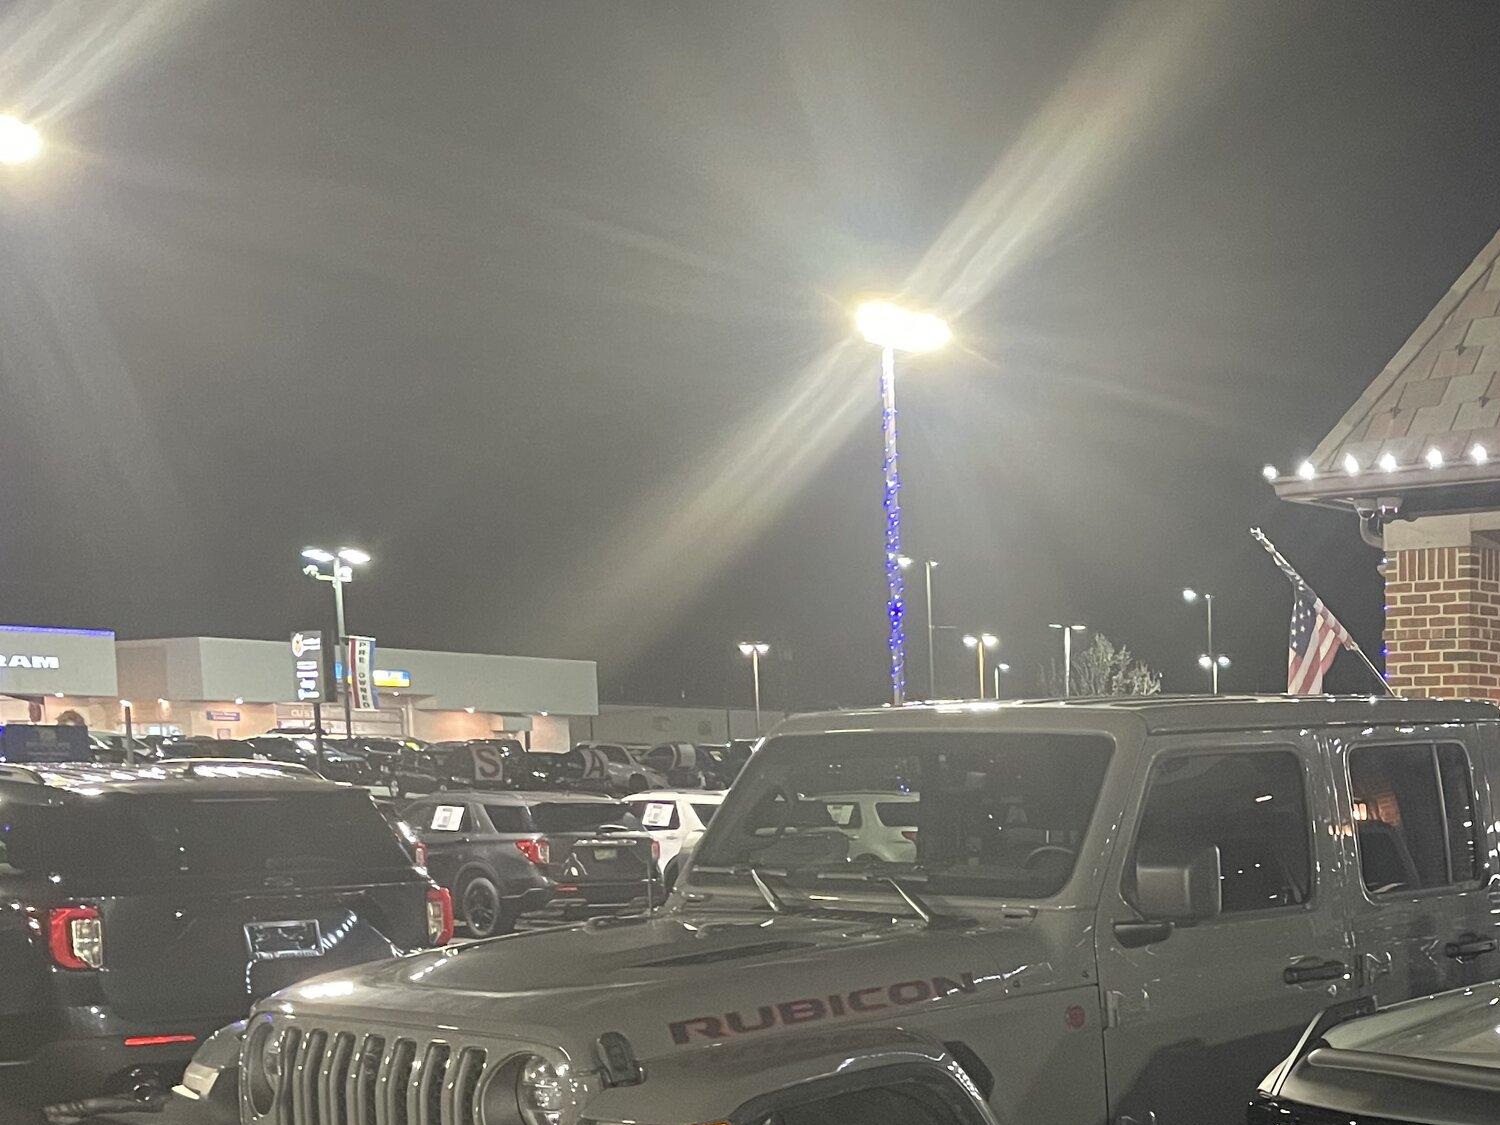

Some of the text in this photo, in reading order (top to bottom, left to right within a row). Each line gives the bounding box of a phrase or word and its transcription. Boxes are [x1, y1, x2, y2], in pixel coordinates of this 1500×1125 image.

[358, 641, 371, 709] PRE OWNED
[668, 972, 977, 1045] RUBICON
